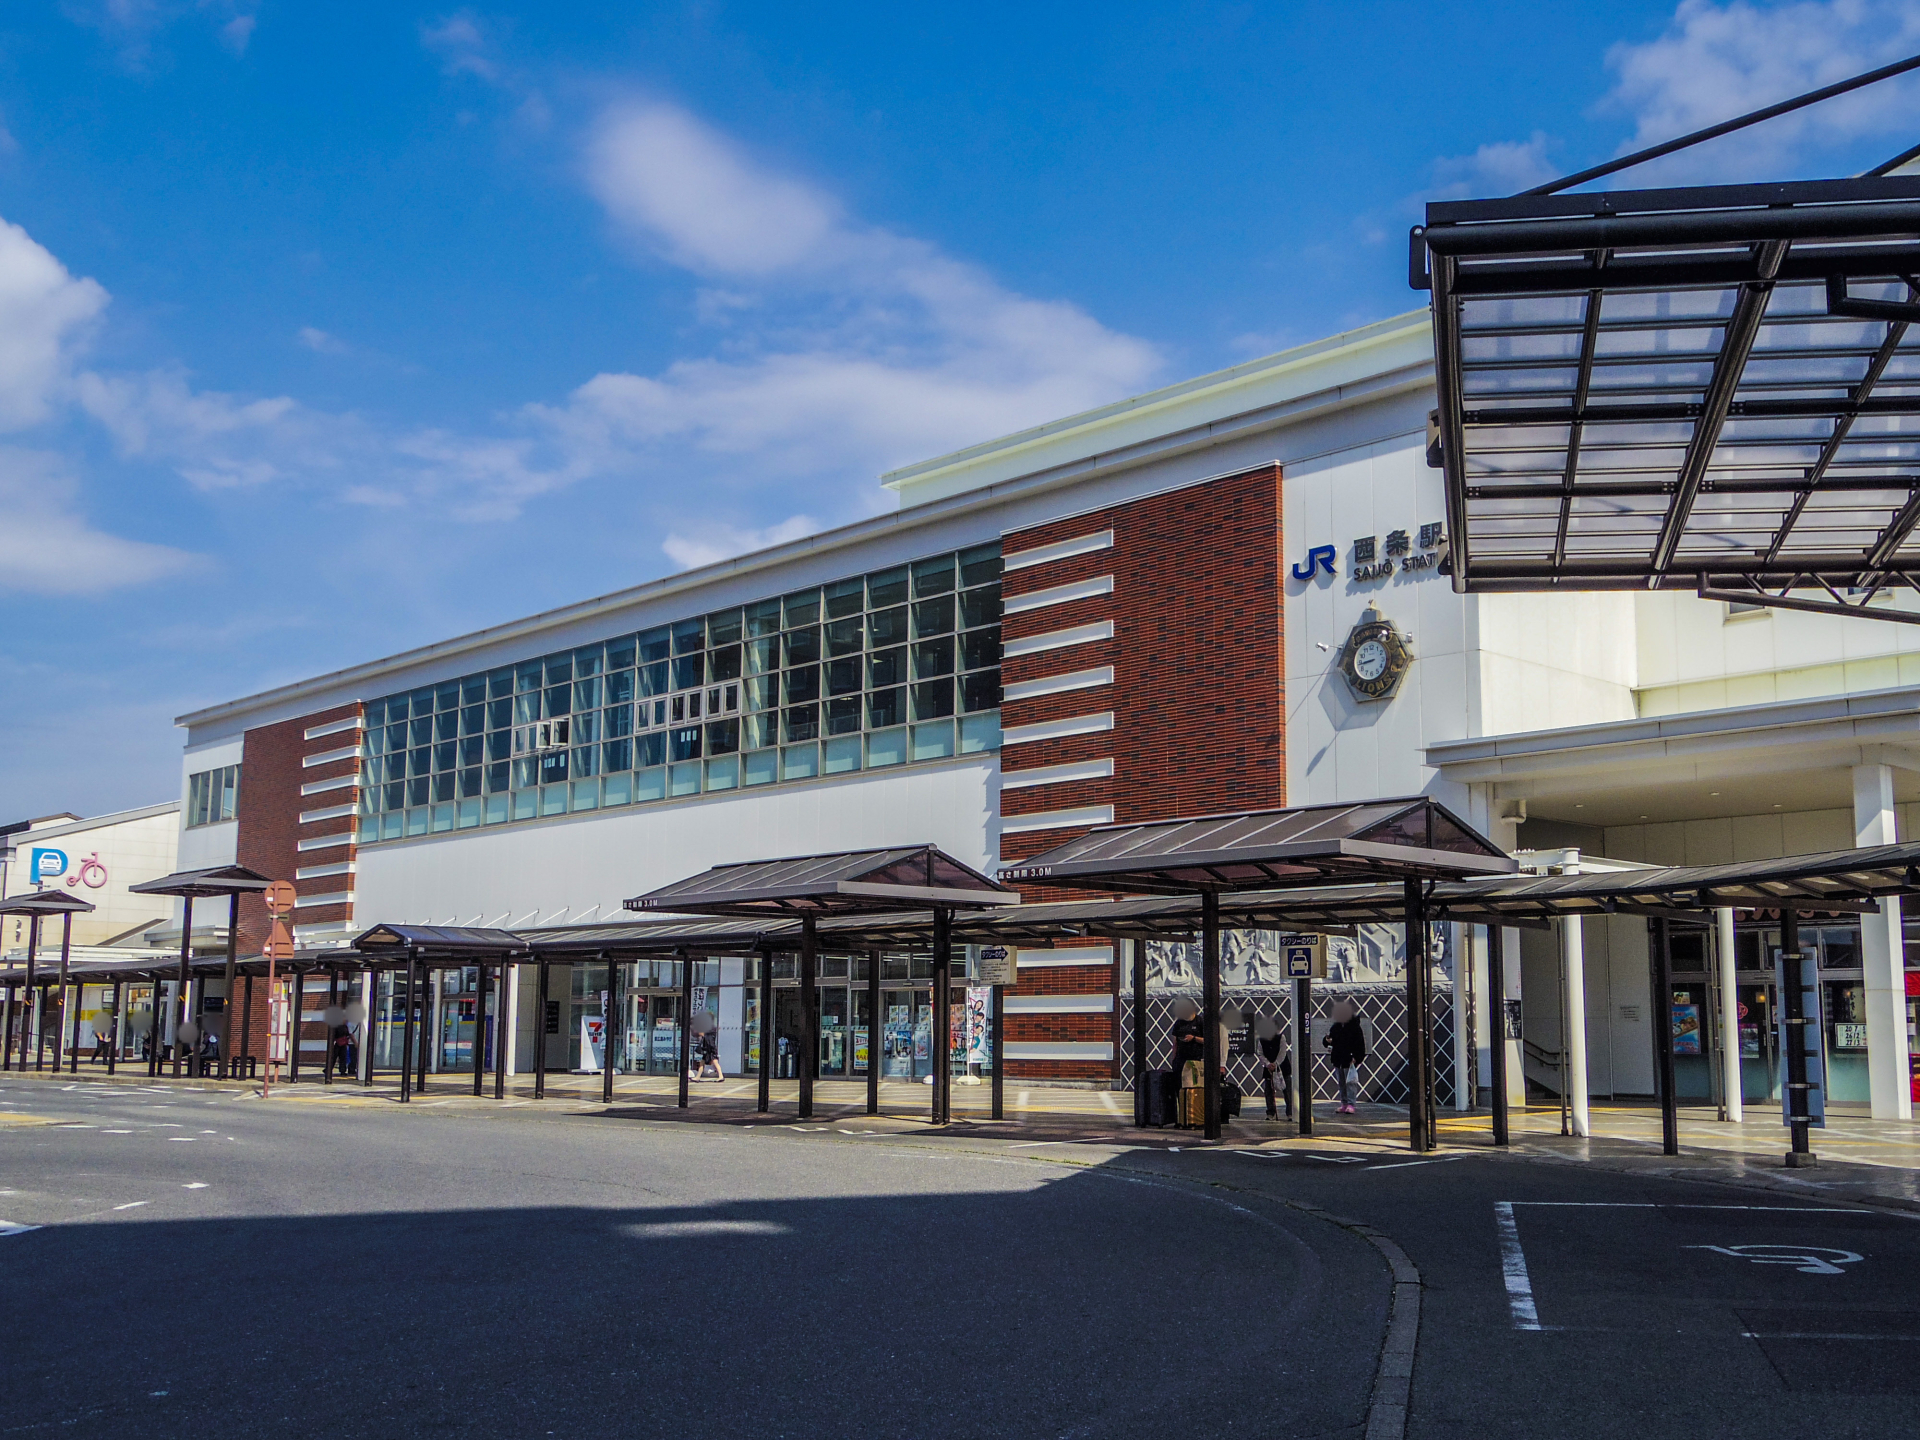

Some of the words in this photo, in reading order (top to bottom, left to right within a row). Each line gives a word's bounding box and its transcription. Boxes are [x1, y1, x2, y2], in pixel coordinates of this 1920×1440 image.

[1353, 521, 1442, 563] 西条駅
[1292, 544, 1338, 580] JR
[1402, 552, 1438, 571] STAT
[30, 847, 69, 885] P
[1030, 867, 1052, 876] 3.0M
[1282, 936, 1317, 946] タクシーのりば
